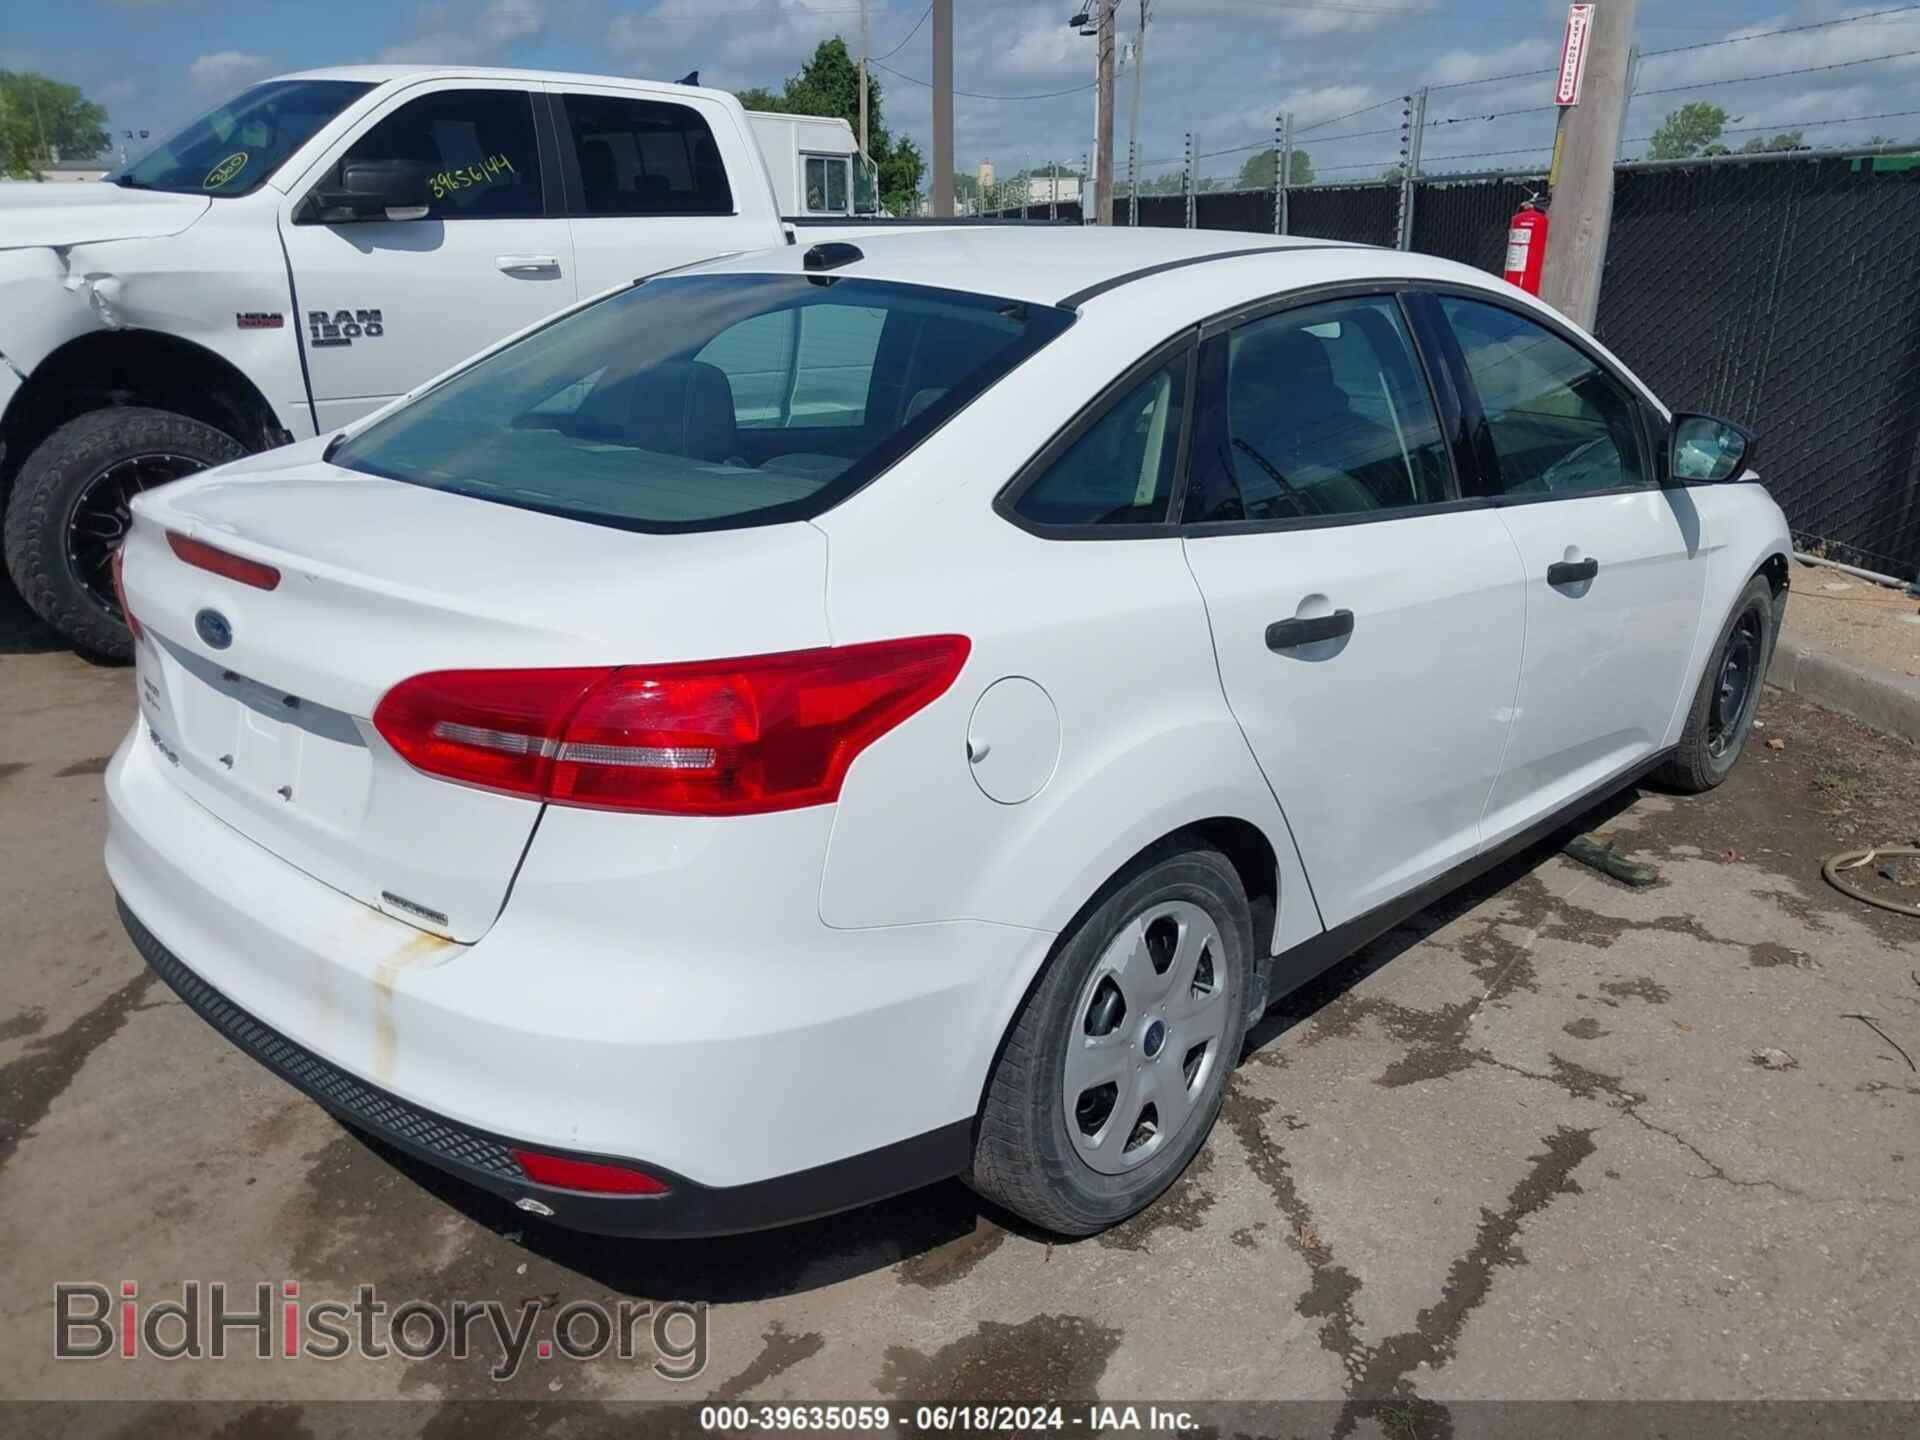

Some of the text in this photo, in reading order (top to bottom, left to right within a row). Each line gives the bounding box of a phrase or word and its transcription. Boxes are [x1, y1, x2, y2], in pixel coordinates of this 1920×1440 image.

[1563, 20, 1579, 96] EXTINGUISHER
[308, 309, 382, 324] RAM
[310, 322, 384, 338] 1500
